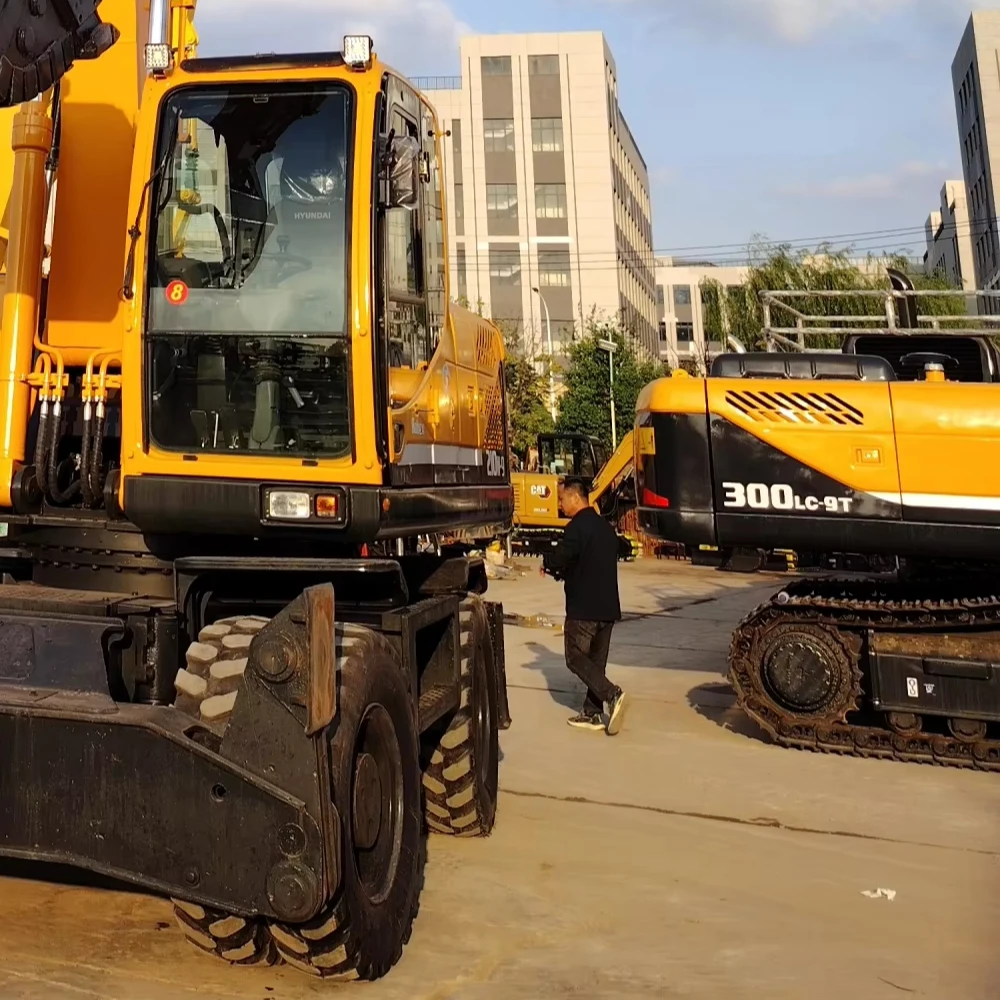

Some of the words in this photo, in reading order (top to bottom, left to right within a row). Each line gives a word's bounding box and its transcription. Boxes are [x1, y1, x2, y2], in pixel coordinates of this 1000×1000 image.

[294, 212, 331, 220] HYUNDAI
[171, 284, 183, 300] 8
[530, 485, 547, 496] CAT
